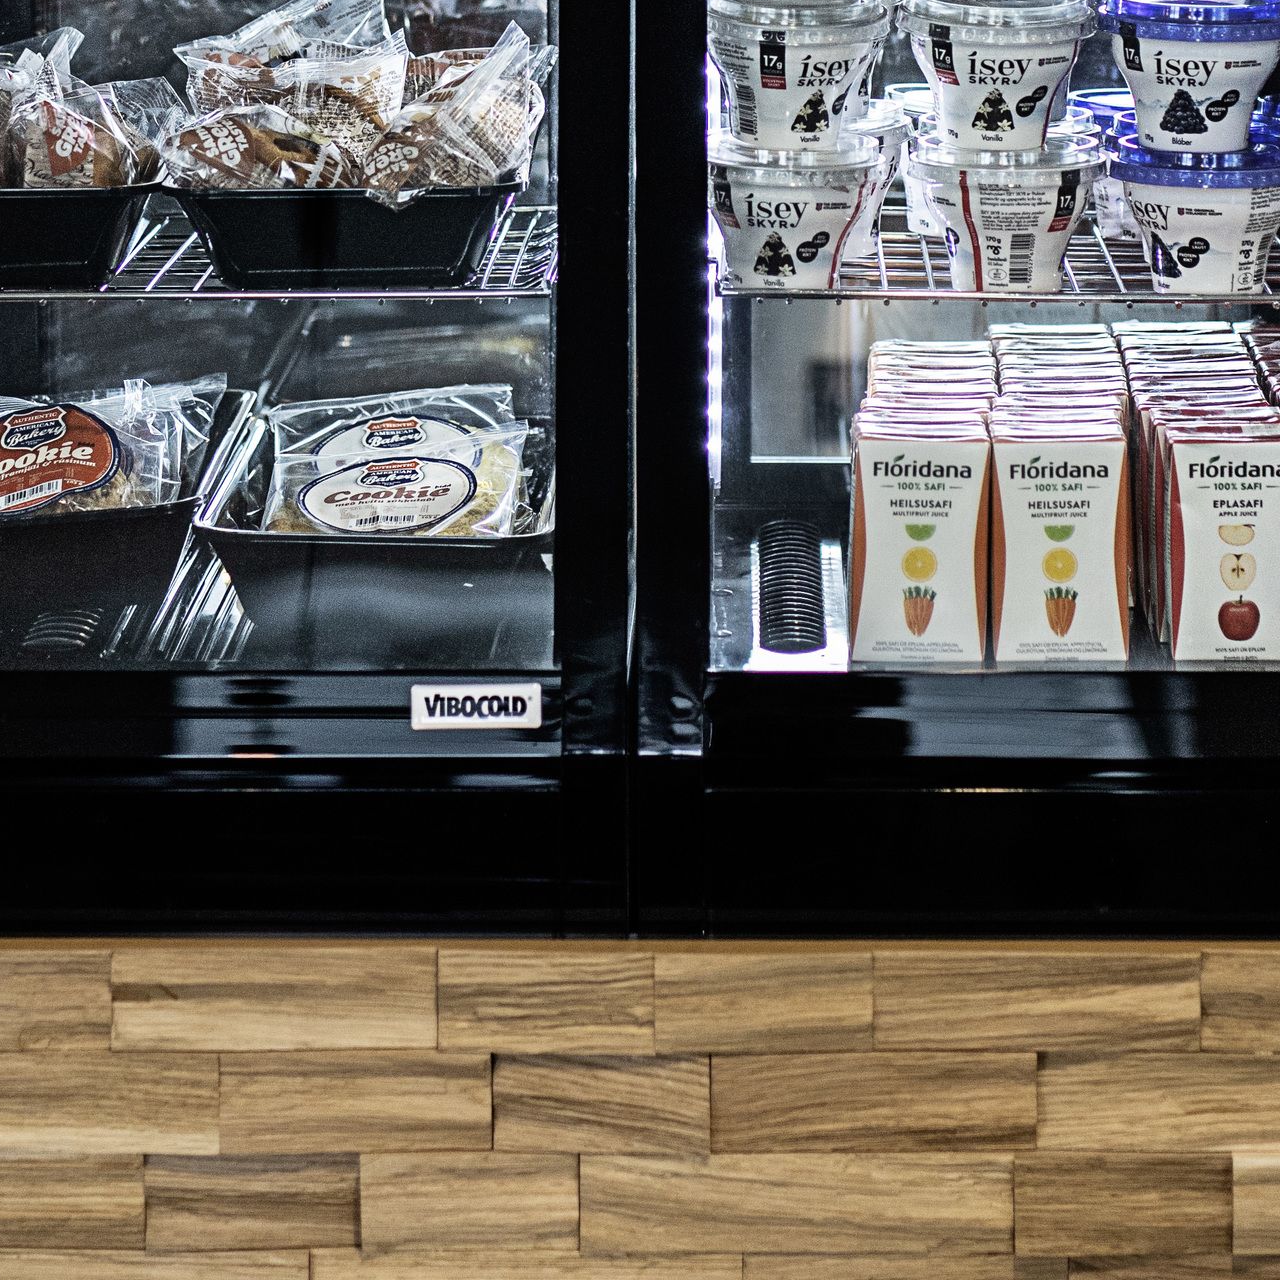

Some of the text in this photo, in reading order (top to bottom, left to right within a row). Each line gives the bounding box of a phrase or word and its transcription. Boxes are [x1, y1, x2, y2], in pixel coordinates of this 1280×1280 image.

[934, 47, 951, 63] 17g
[763, 55, 783, 70] 17g
[967, 51, 1034, 85] ísey
[1153, 50, 1219, 87] ísey
[797, 79, 835, 87] SKYR
[969, 75, 1011, 85] SKYR
[1156, 75, 1197, 87] SKYR
[981, 133, 1004, 142] Vanilla
[745, 193, 810, 229] ísey
[748, 218, 788, 229] SKYR
[763, 278, 785, 287] Vanilla
[12, 411, 58, 425] AUTHENTIC
[13, 421, 55, 433] AMERICAN
[372, 422, 415, 430] AUTHENTIC
[6, 425, 65, 447] Bakery
[368, 433, 424, 447] Bakery
[370, 462, 416, 471] AUTHENTIC
[363, 473, 420, 485] Bakery
[897, 482, 946, 491] 100% SAFI
[1213, 482, 1262, 491] 100% SAFI
[323, 486, 451, 505] Cookie
[890, 499, 952, 509] HEILSUSAFI
[1028, 500, 1091, 510] HEILSUSAFI
[1212, 499, 1264, 508] EPLASAFI
[424, 694, 528, 719] VIBOCOLD
